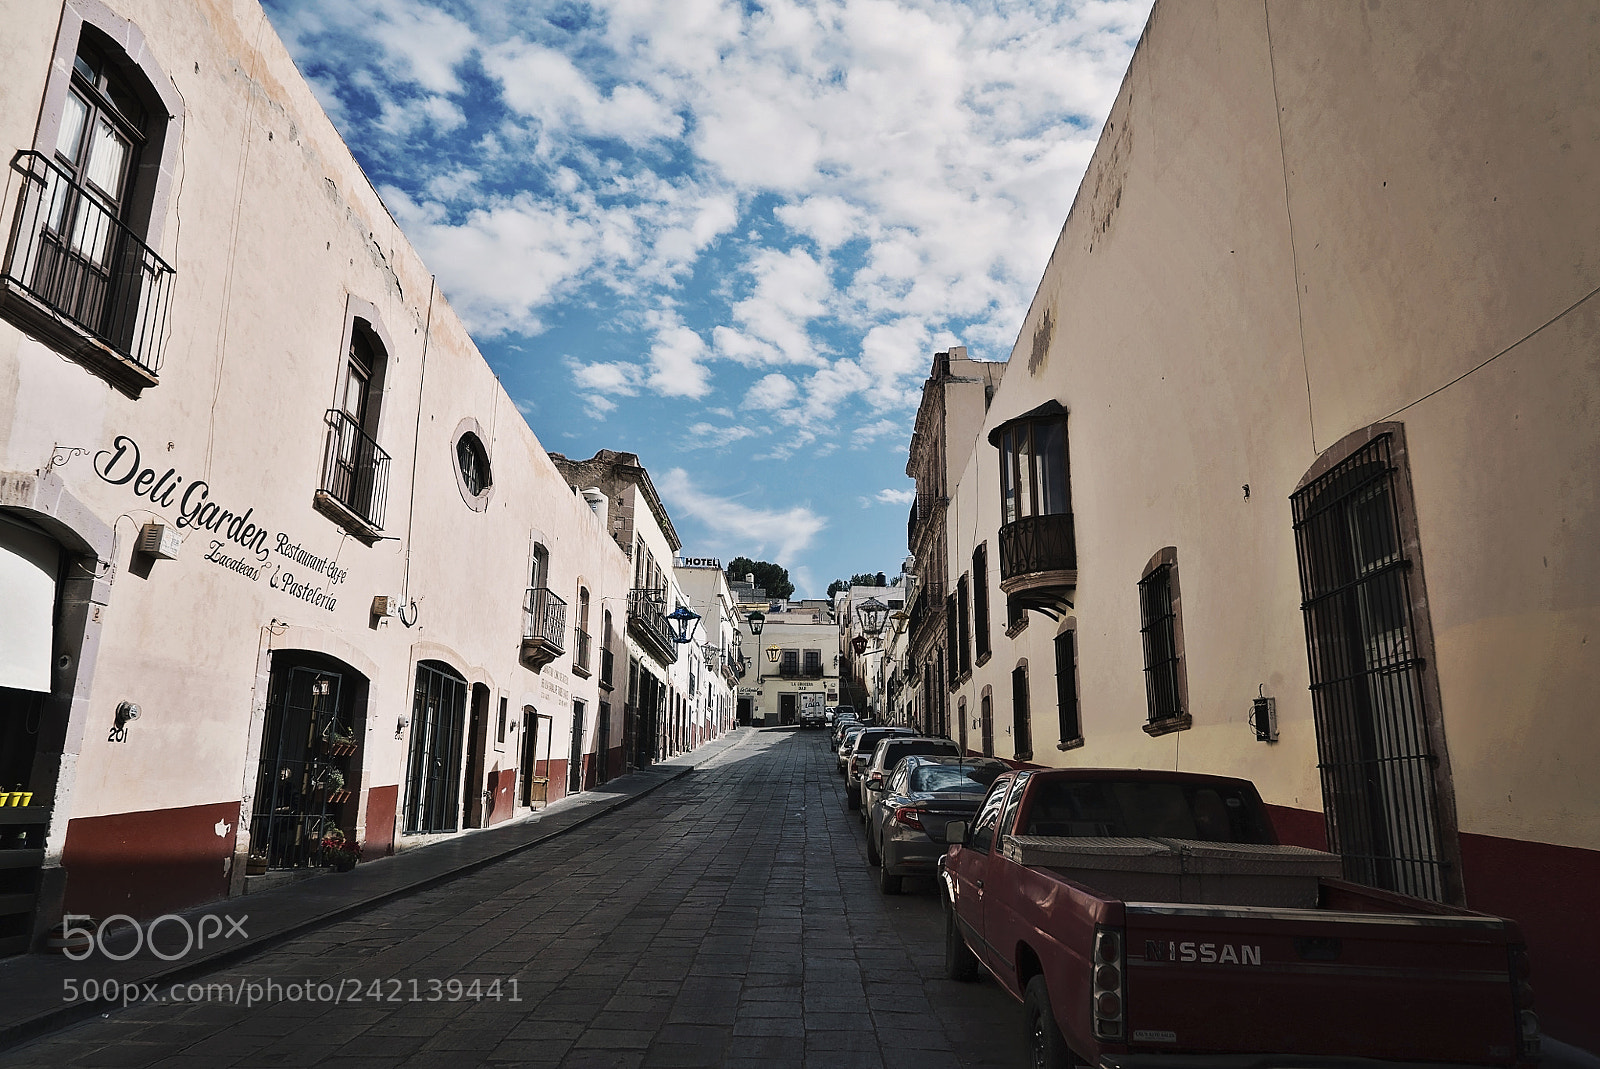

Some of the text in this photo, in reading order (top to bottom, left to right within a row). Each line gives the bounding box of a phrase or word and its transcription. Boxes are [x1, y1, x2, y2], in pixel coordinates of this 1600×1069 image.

[94, 436, 269, 561] Deli Garden
[204, 540, 260, 581] Zacatecas
[274, 533, 349, 585] Restaurant-Café
[686, 558, 717, 566] HOTEL
[281, 573, 337, 612] Pastelería
[108, 728, 128, 743] 201
[1145, 940, 1261, 965] NISSAN
